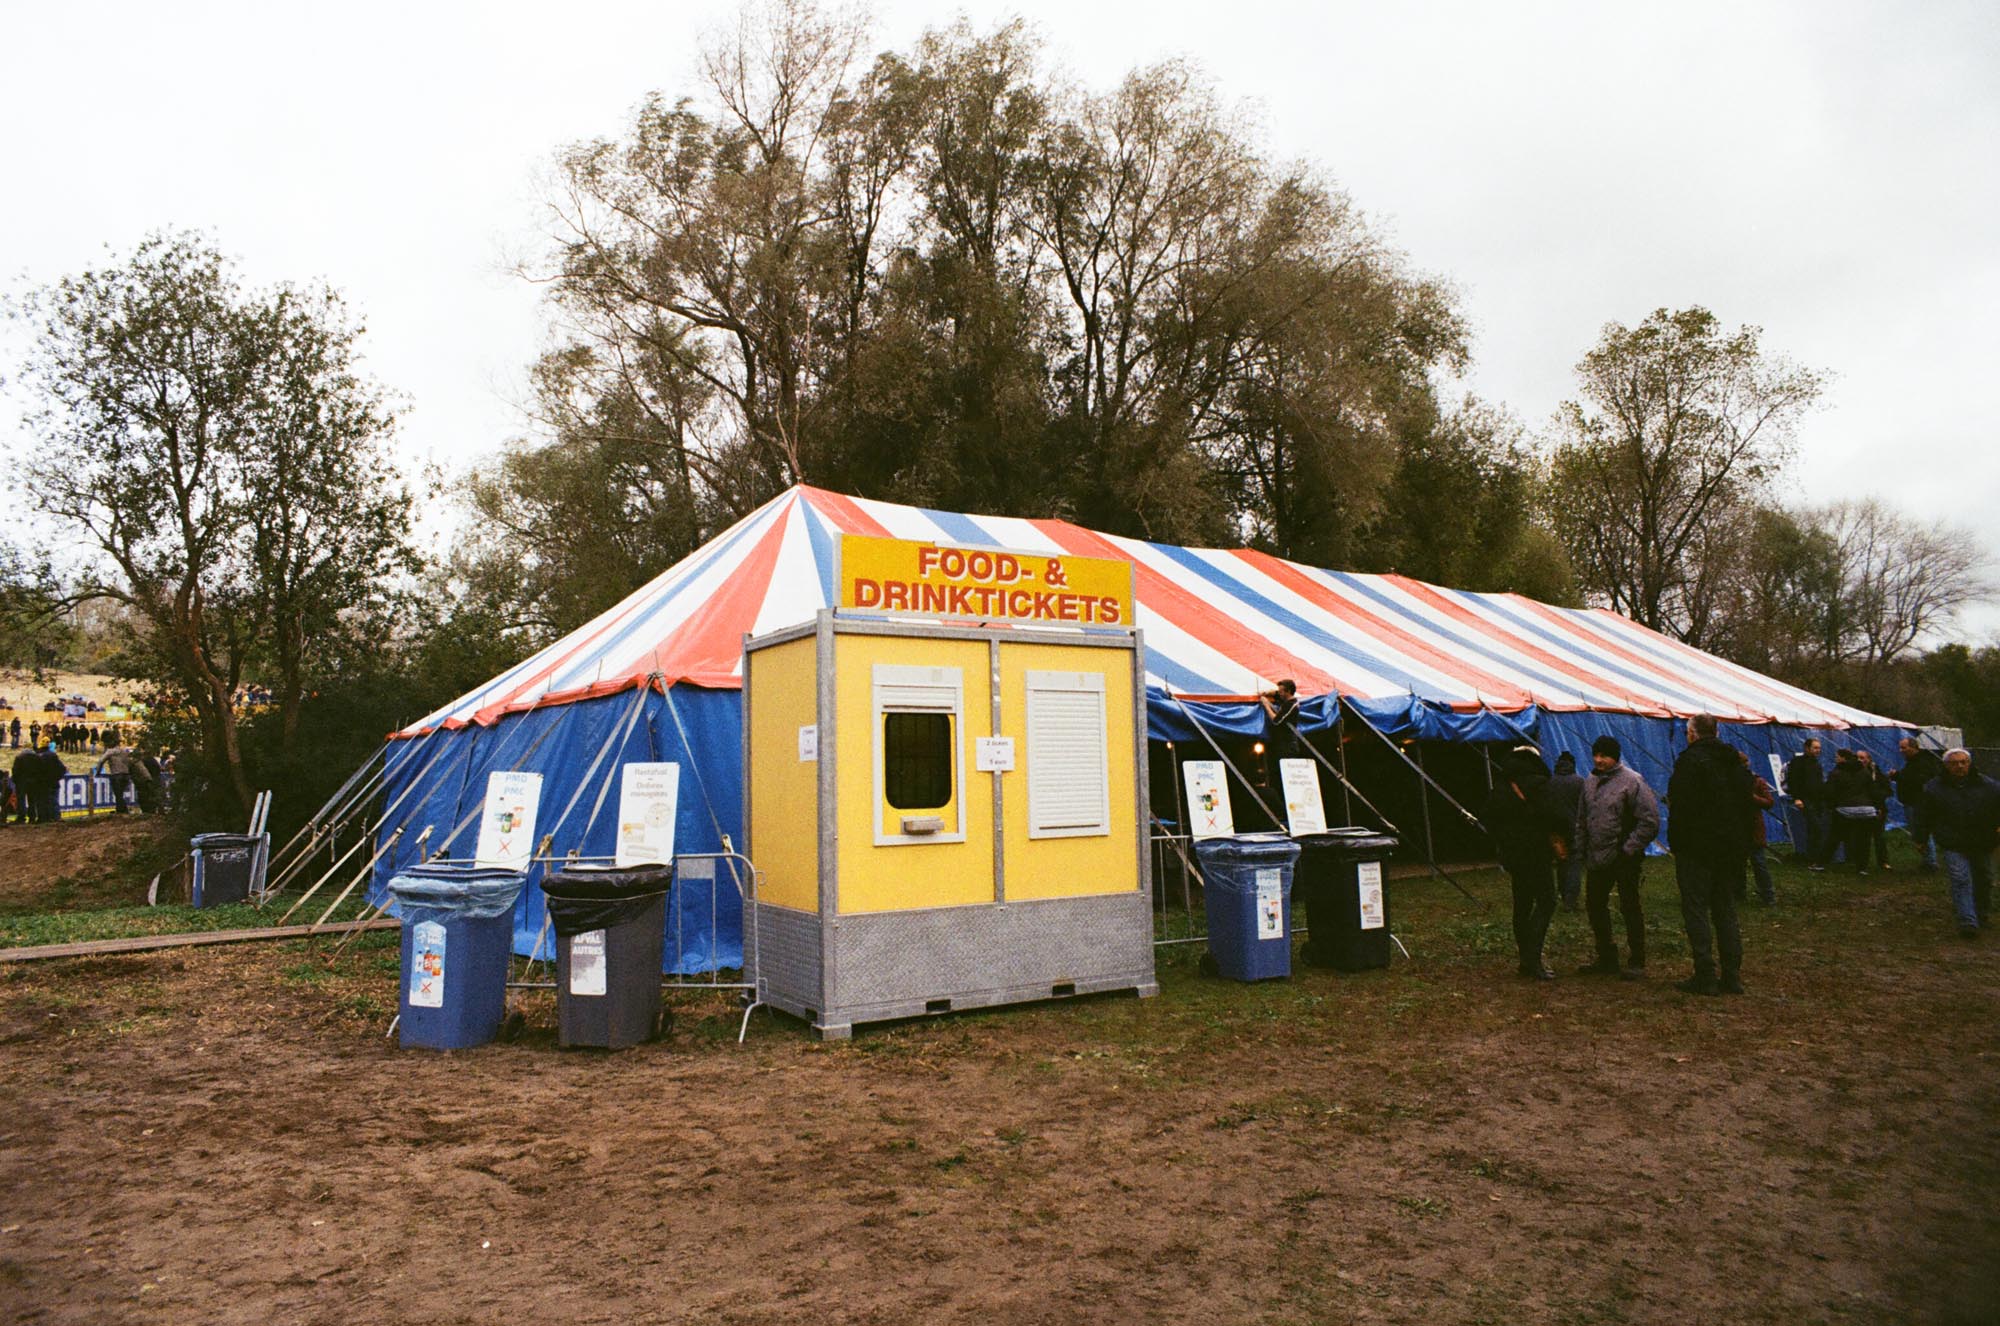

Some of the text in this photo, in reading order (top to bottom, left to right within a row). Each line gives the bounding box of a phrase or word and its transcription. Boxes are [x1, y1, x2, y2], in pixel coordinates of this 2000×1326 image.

[918, 546, 1069, 589] FOOD- &
[853, 577, 1123, 625] DRINKTICKETS
[505, 774, 527, 783] PMD
